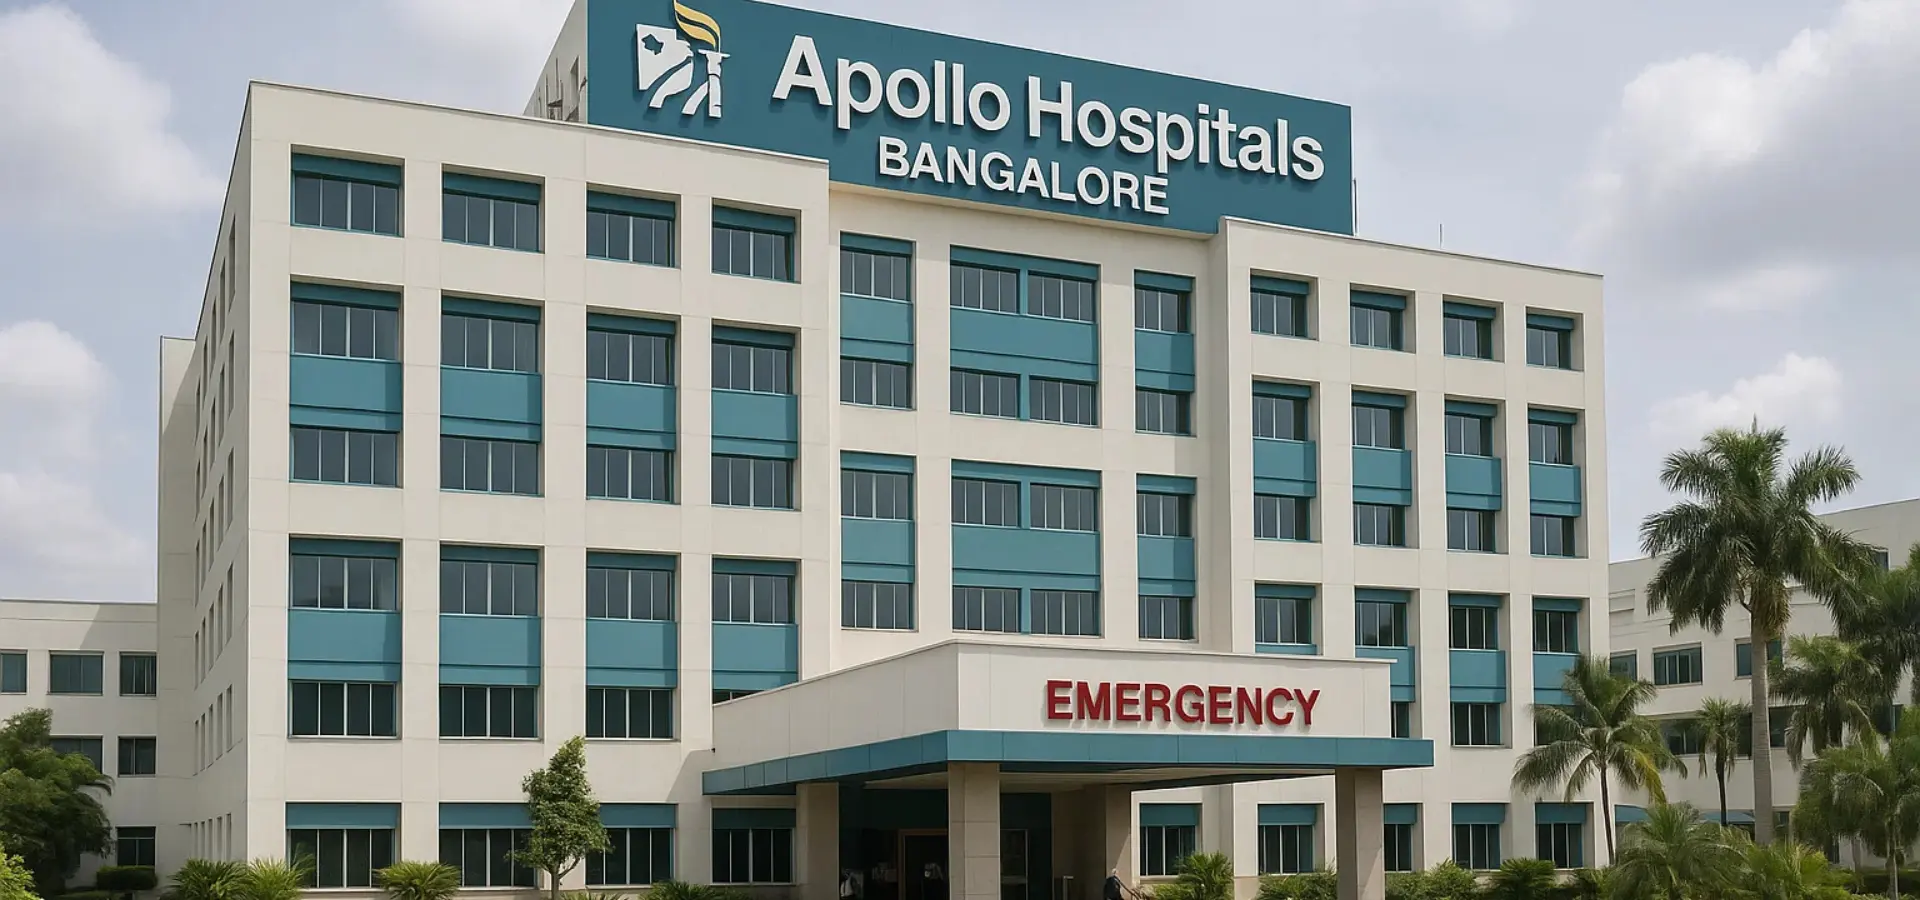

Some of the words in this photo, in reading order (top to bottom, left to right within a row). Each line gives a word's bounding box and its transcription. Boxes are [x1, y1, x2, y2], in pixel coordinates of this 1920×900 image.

[772, 34, 1011, 131] Apollo
[1028, 75, 1326, 181] Hospitals
[879, 136, 1169, 215] BANGALORE
[1046, 680, 1320, 726] EMERGENCY
